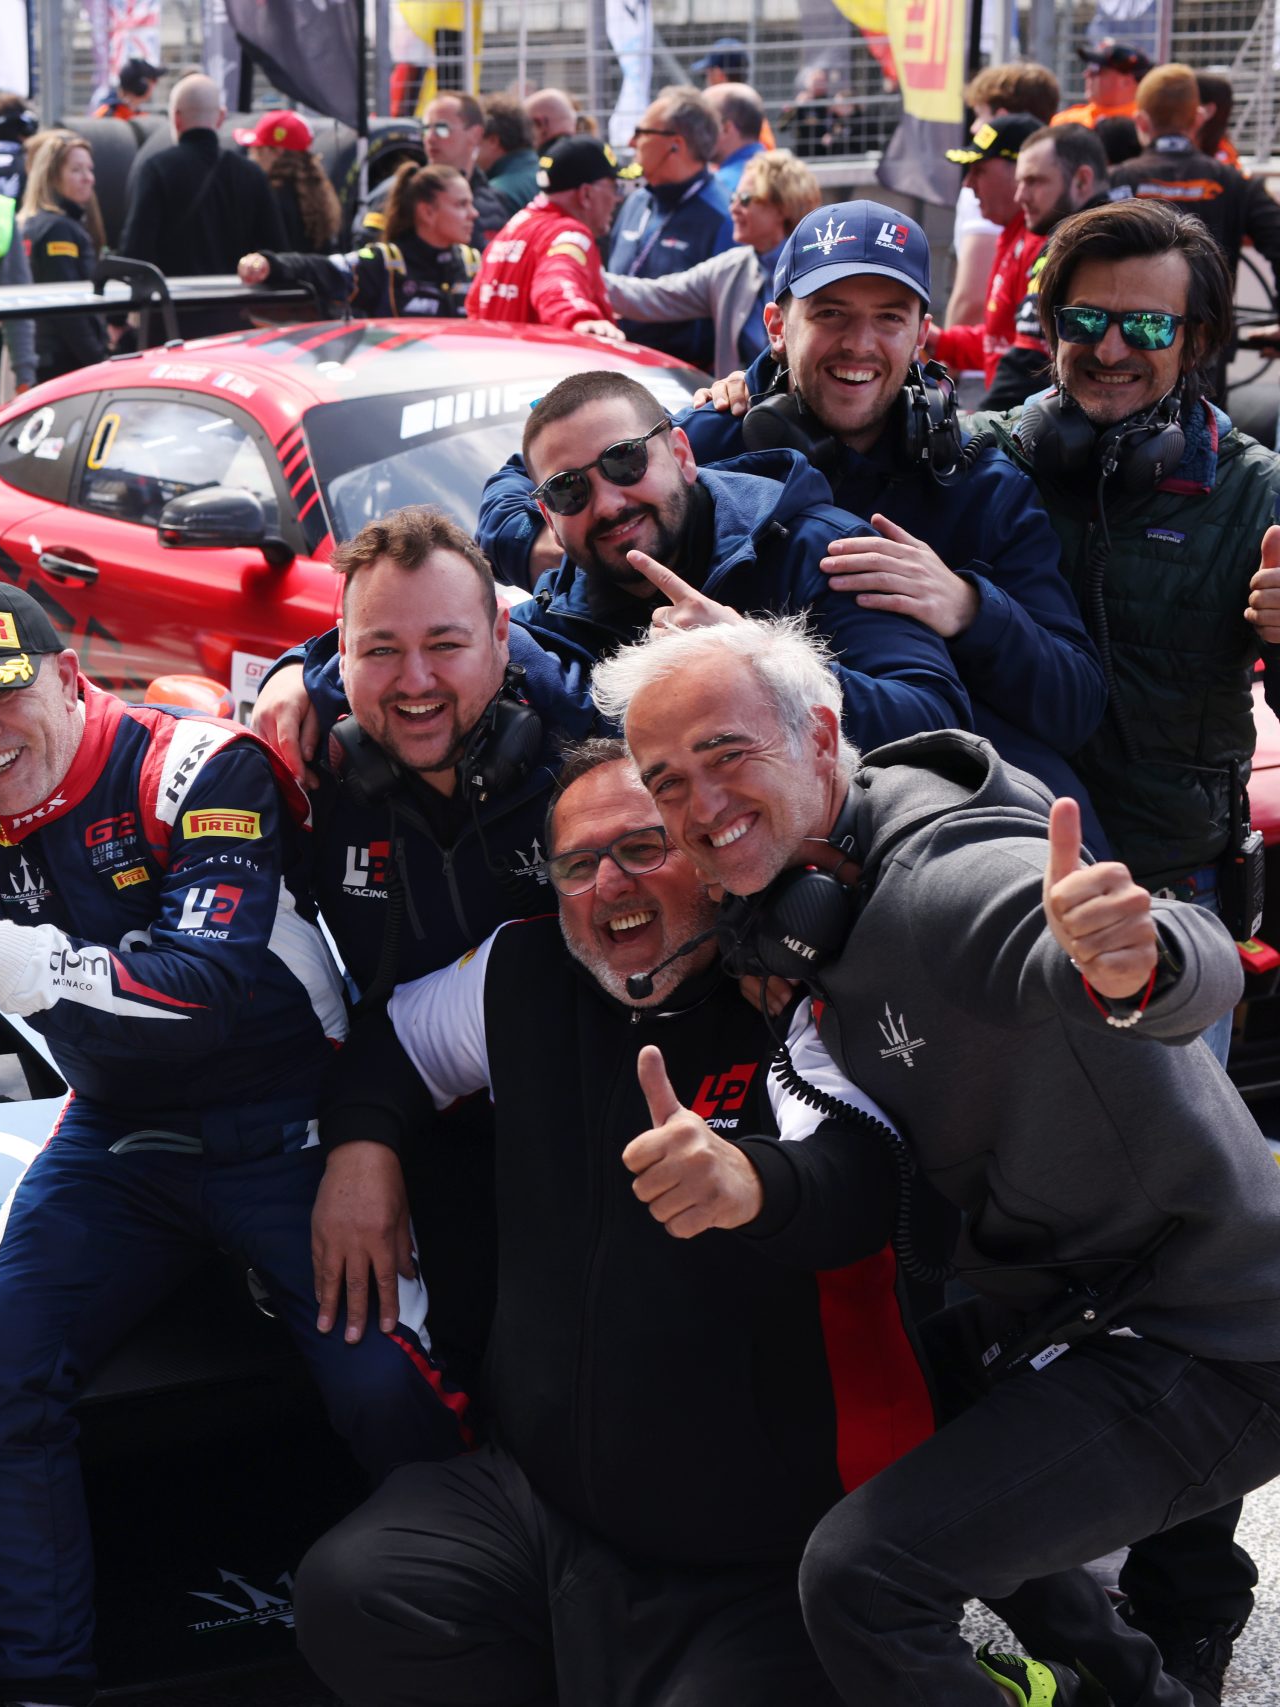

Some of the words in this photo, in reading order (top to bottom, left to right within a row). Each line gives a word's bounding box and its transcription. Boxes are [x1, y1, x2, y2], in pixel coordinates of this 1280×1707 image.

[875, 240, 905, 253] RACING
[189, 813, 256, 834] PIRELLI
[342, 886, 389, 899] RACING
[52, 978, 93, 991] MONACO
[706, 1118, 740, 1129] CING
[1040, 1351, 1055, 1362] CAR
